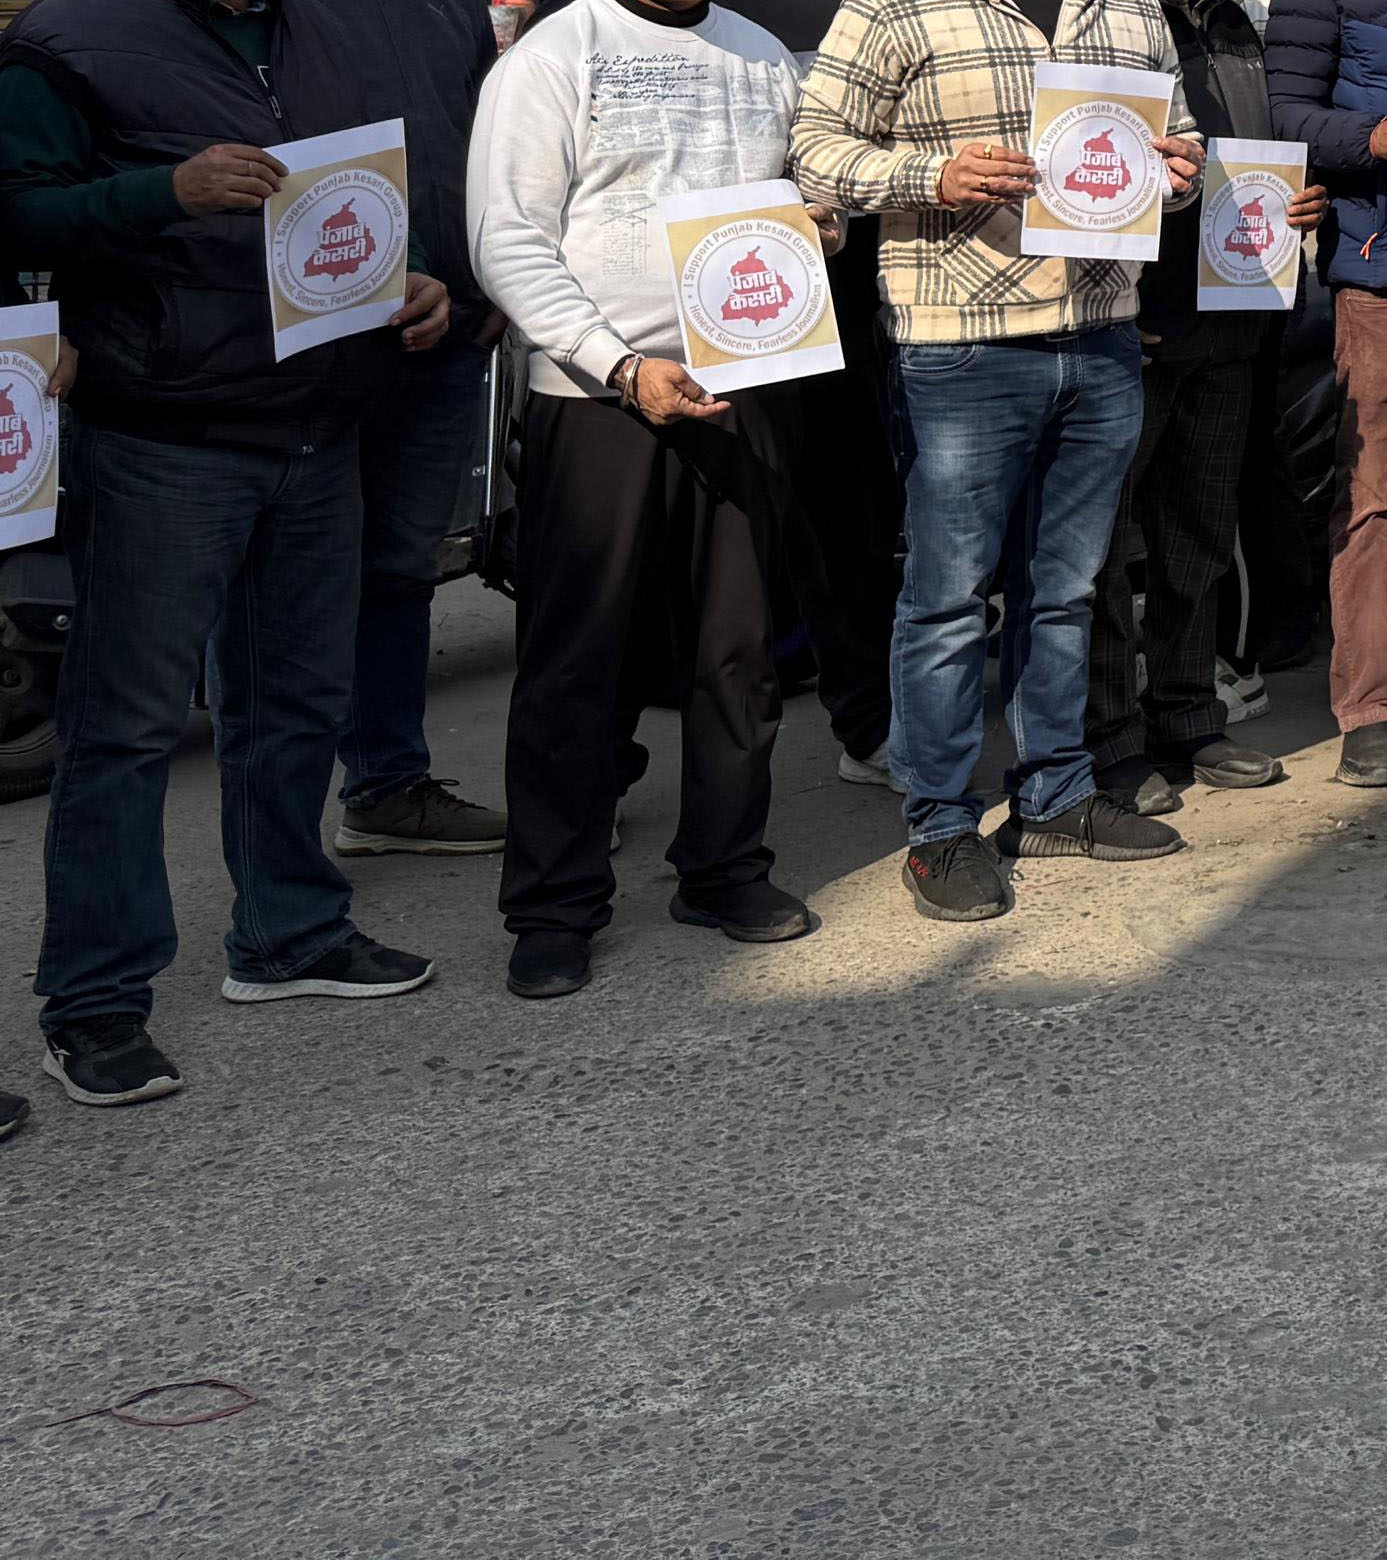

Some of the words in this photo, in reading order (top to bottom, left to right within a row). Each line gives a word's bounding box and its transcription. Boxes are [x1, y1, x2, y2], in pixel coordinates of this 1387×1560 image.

[684, 239, 714, 281] Support
[712, 222, 753, 242] Punjab
[756, 222, 792, 241] Kesari
[792, 237, 817, 268] Group
